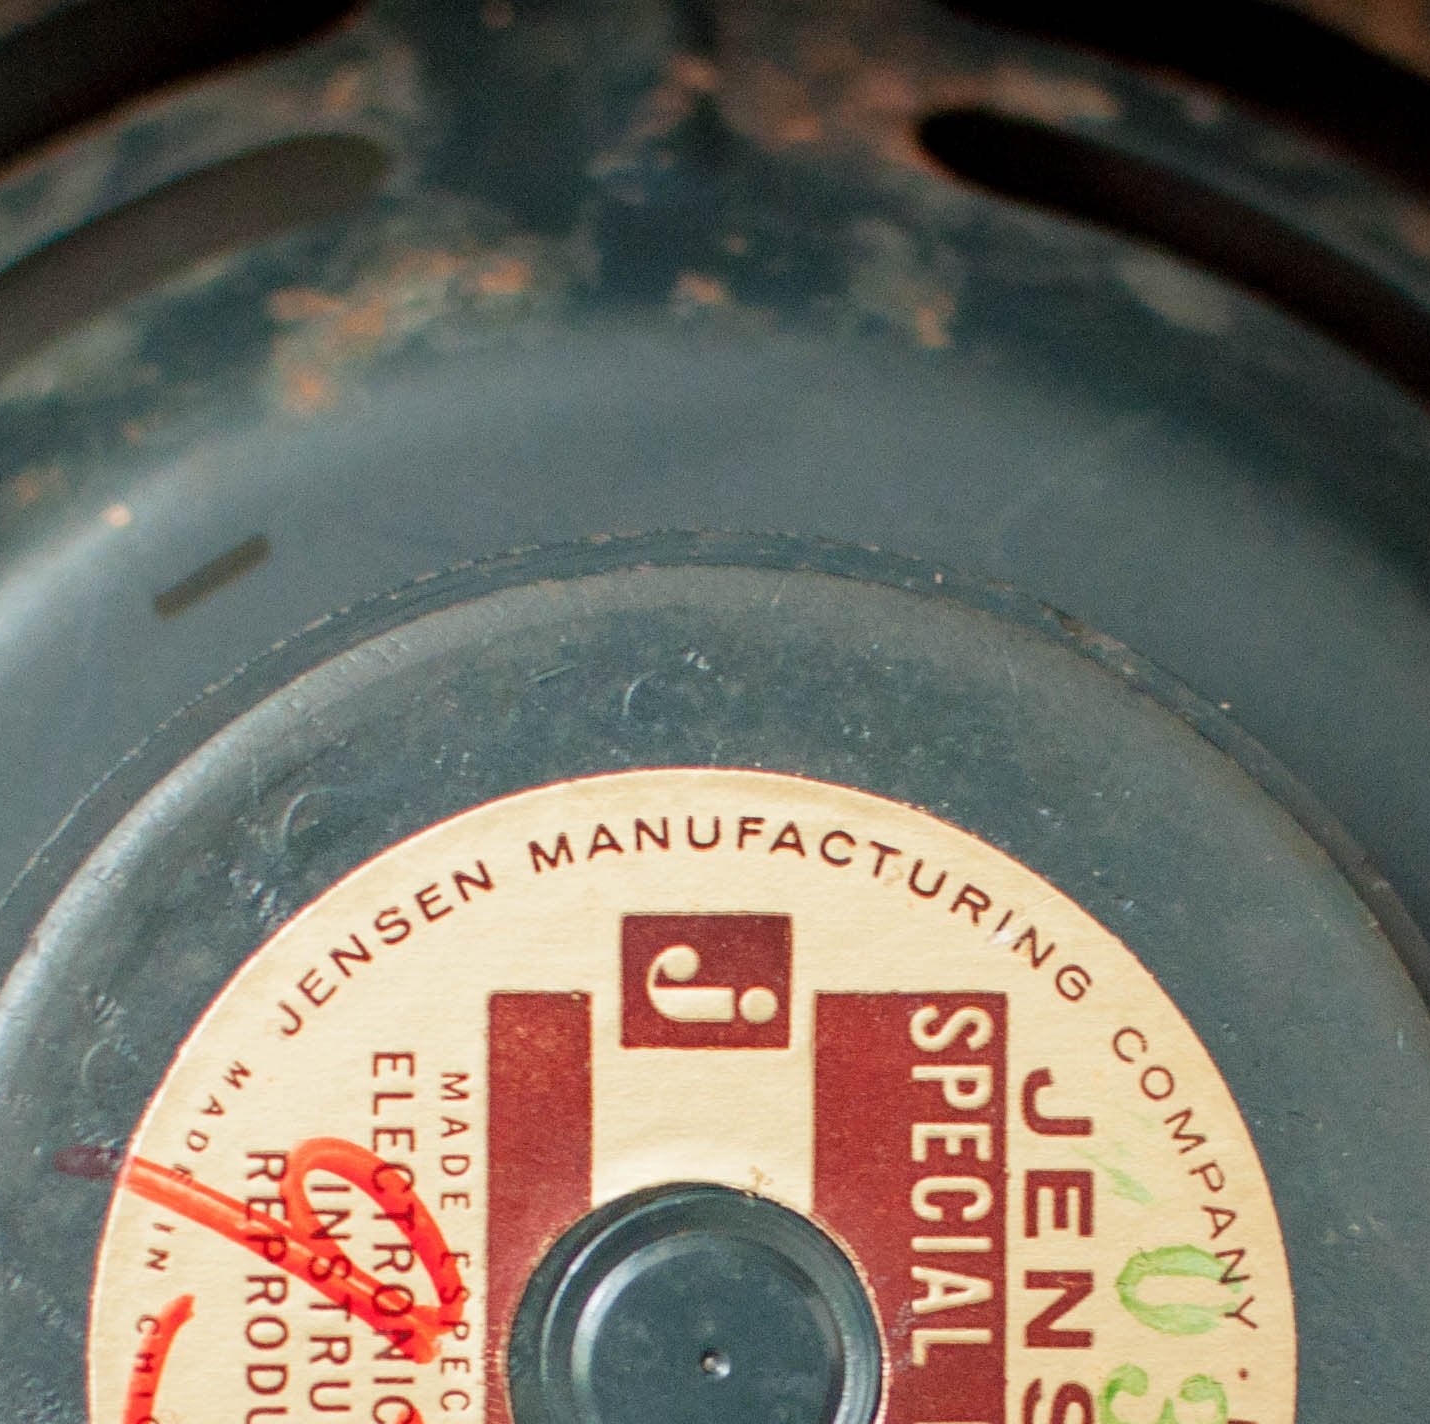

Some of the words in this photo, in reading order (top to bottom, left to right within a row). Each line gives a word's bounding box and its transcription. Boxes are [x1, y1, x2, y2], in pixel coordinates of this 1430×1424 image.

[172, 1060, 252, 1182] MADE
[279, 860, 495, 1037] JENSEN
[528, 816, 1093, 1002] MANUFACTURING
[1112, 1026, 1259, 1330] COMPANY
[440, 1071, 470, 1210] MADE
[148, 1222, 174, 1271] IN
[910, 1005, 993, 1367] SPECIAL
